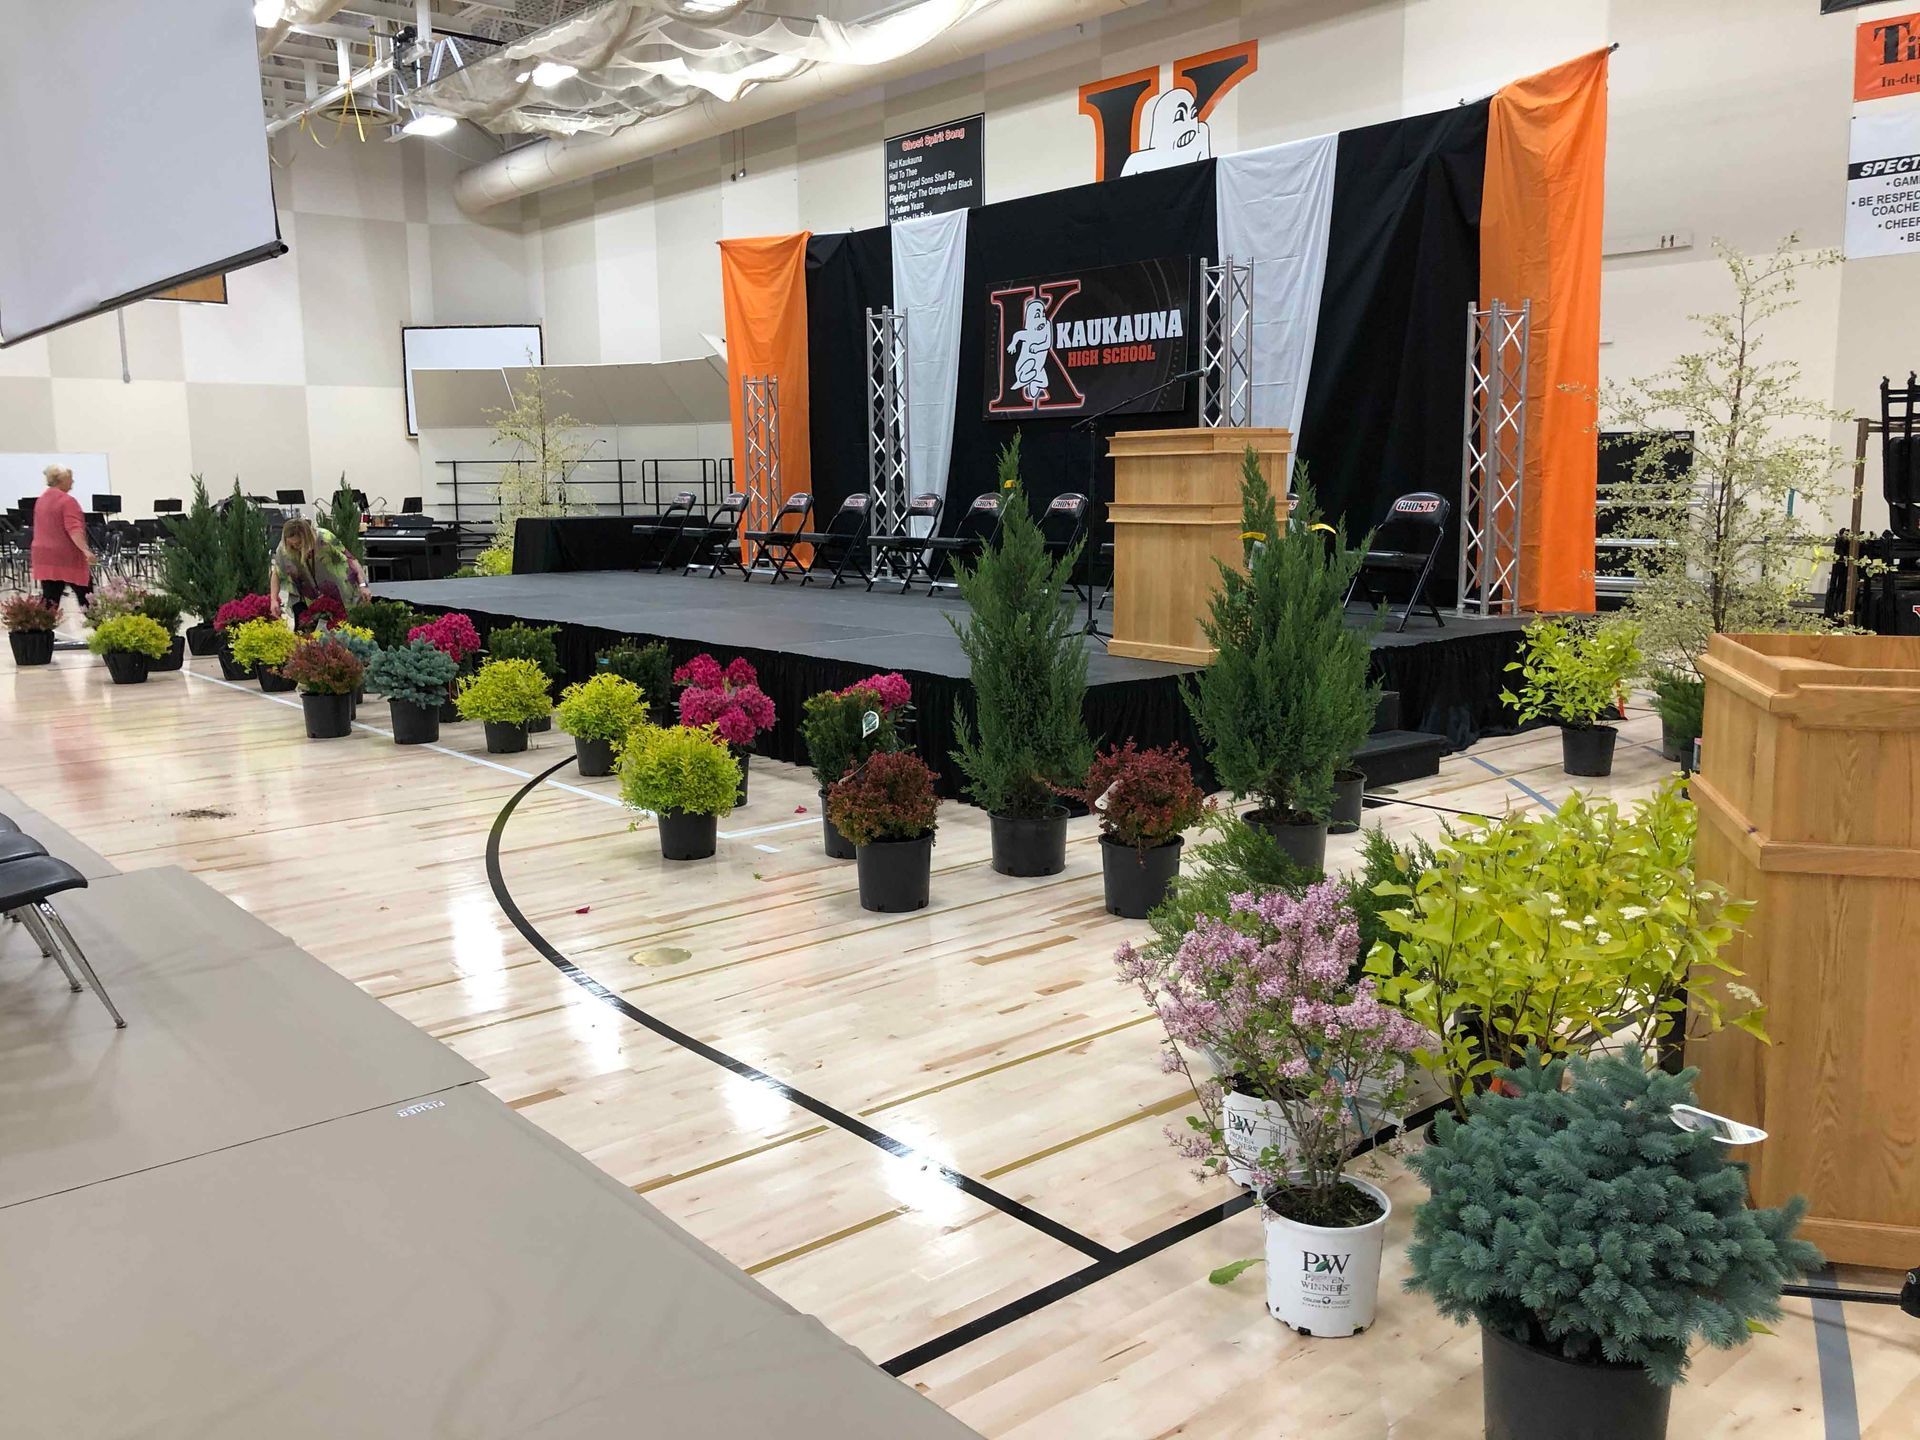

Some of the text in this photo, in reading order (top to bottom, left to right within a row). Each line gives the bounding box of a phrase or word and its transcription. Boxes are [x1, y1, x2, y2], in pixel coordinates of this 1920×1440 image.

[1873, 22, 1920, 65] Ti
[901, 128, 965, 151] Ghost Spirit Song
[888, 155, 923, 170] Hail Kaukauna
[1860, 156, 1920, 177] SPECT
[888, 168, 918, 181] Hail To Thee
[889, 170, 955, 192] We Thy Loyal Sons Shall Be
[889, 178, 973, 205] Fighting For The Orange And Black
[1858, 196, 1873, 207] BE
[889, 201, 925, 215] In Future Years
[1056, 309, 1183, 349] KAUKAUNA
[1067, 344, 1156, 367] HIGH SCHOOL
[1397, 501, 1439, 512] GHOSTS
[396, 1100, 446, 1117] FISHER
[1227, 1110, 1257, 1136] PW
[1301, 1250, 1351, 1275] PW
